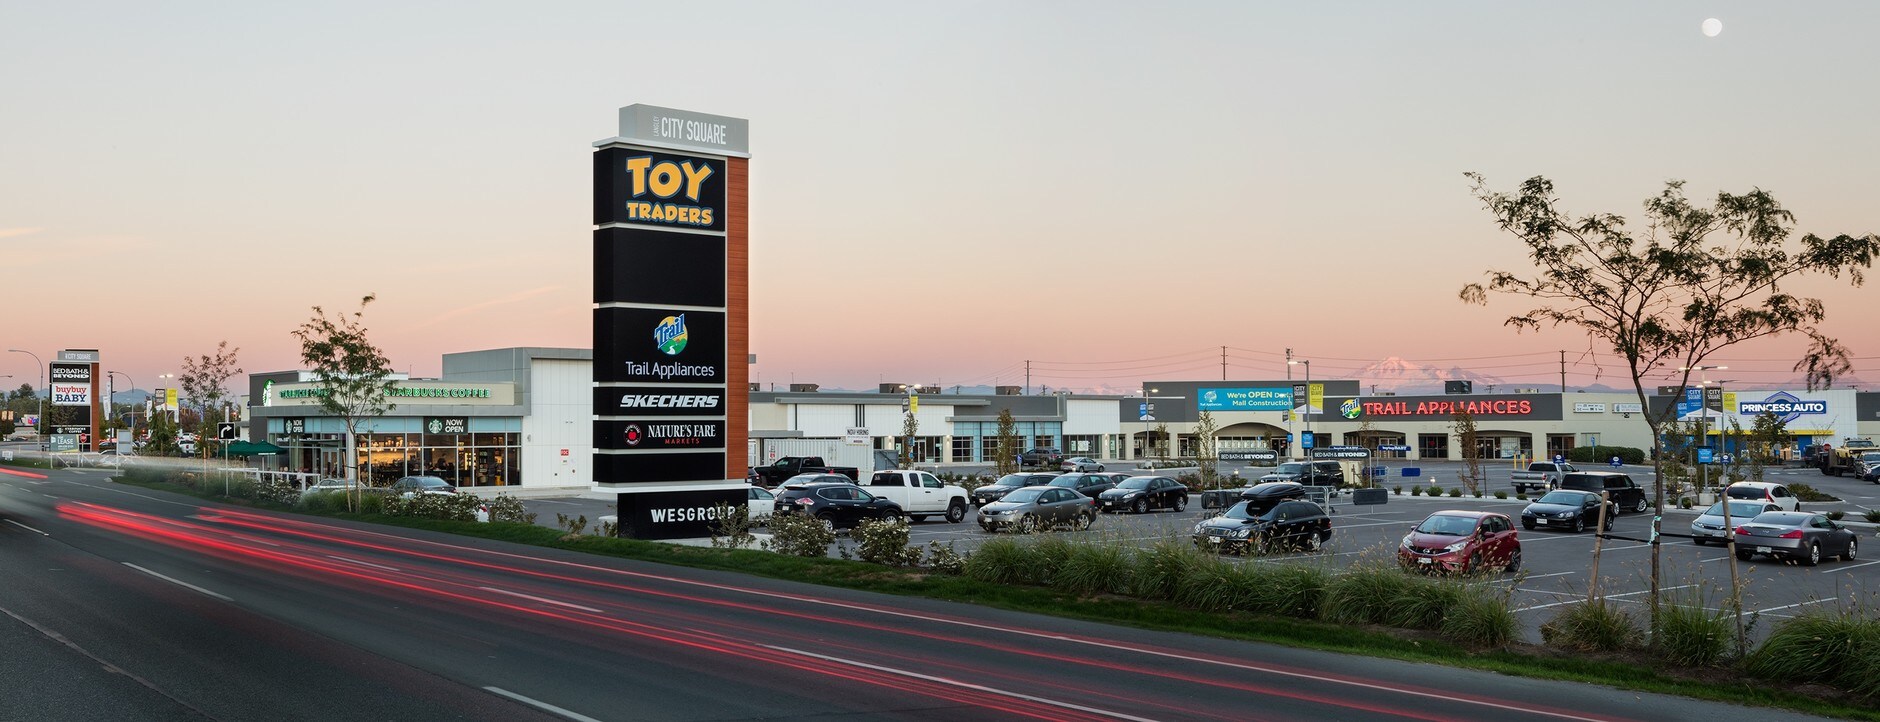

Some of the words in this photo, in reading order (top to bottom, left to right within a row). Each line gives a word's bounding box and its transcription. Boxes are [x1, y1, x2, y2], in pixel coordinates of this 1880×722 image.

[661, 117, 684, 139] CITY
[686, 120, 727, 145] SQUARE
[626, 156, 713, 202] TOY
[627, 201, 714, 226] TRADERS
[654, 313, 685, 350] Trail
[625, 361, 650, 376] Trail
[651, 361, 715, 380] Appliances
[56, 386, 87, 394] buybuy
[383, 387, 450, 398] STARBUCKS
[450, 388, 491, 398] COFFEE
[55, 394, 87, 402] BABY
[620, 394, 720, 408] SKECHERS
[1364, 402, 1412, 415] TRAIL
[1416, 400, 1532, 415] APPLIANCES
[1742, 404, 1792, 412] PRINCESS
[1793, 403, 1824, 411] AUTO
[648, 424, 692, 438] NATURE'S
[694, 424, 717, 438] FARE
[650, 506, 736, 523] WESGROUP
